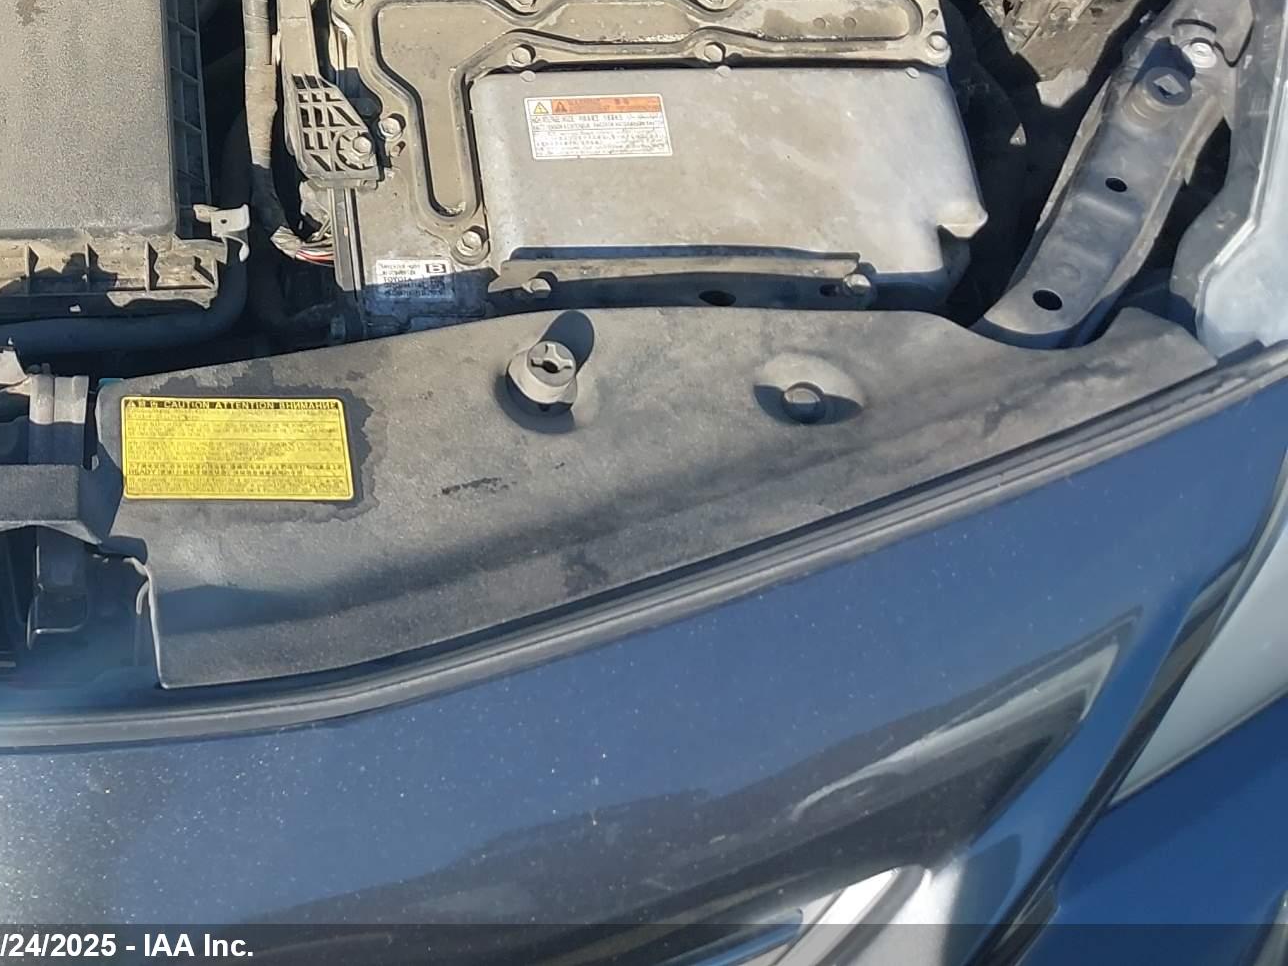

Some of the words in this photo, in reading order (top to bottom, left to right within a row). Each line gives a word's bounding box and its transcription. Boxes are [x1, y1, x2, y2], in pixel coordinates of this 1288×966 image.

[164, 401, 210, 409] CAUTION
[216, 401, 274, 409] ATTENTION
[280, 401, 337, 409] ВНИМАНИЕ
